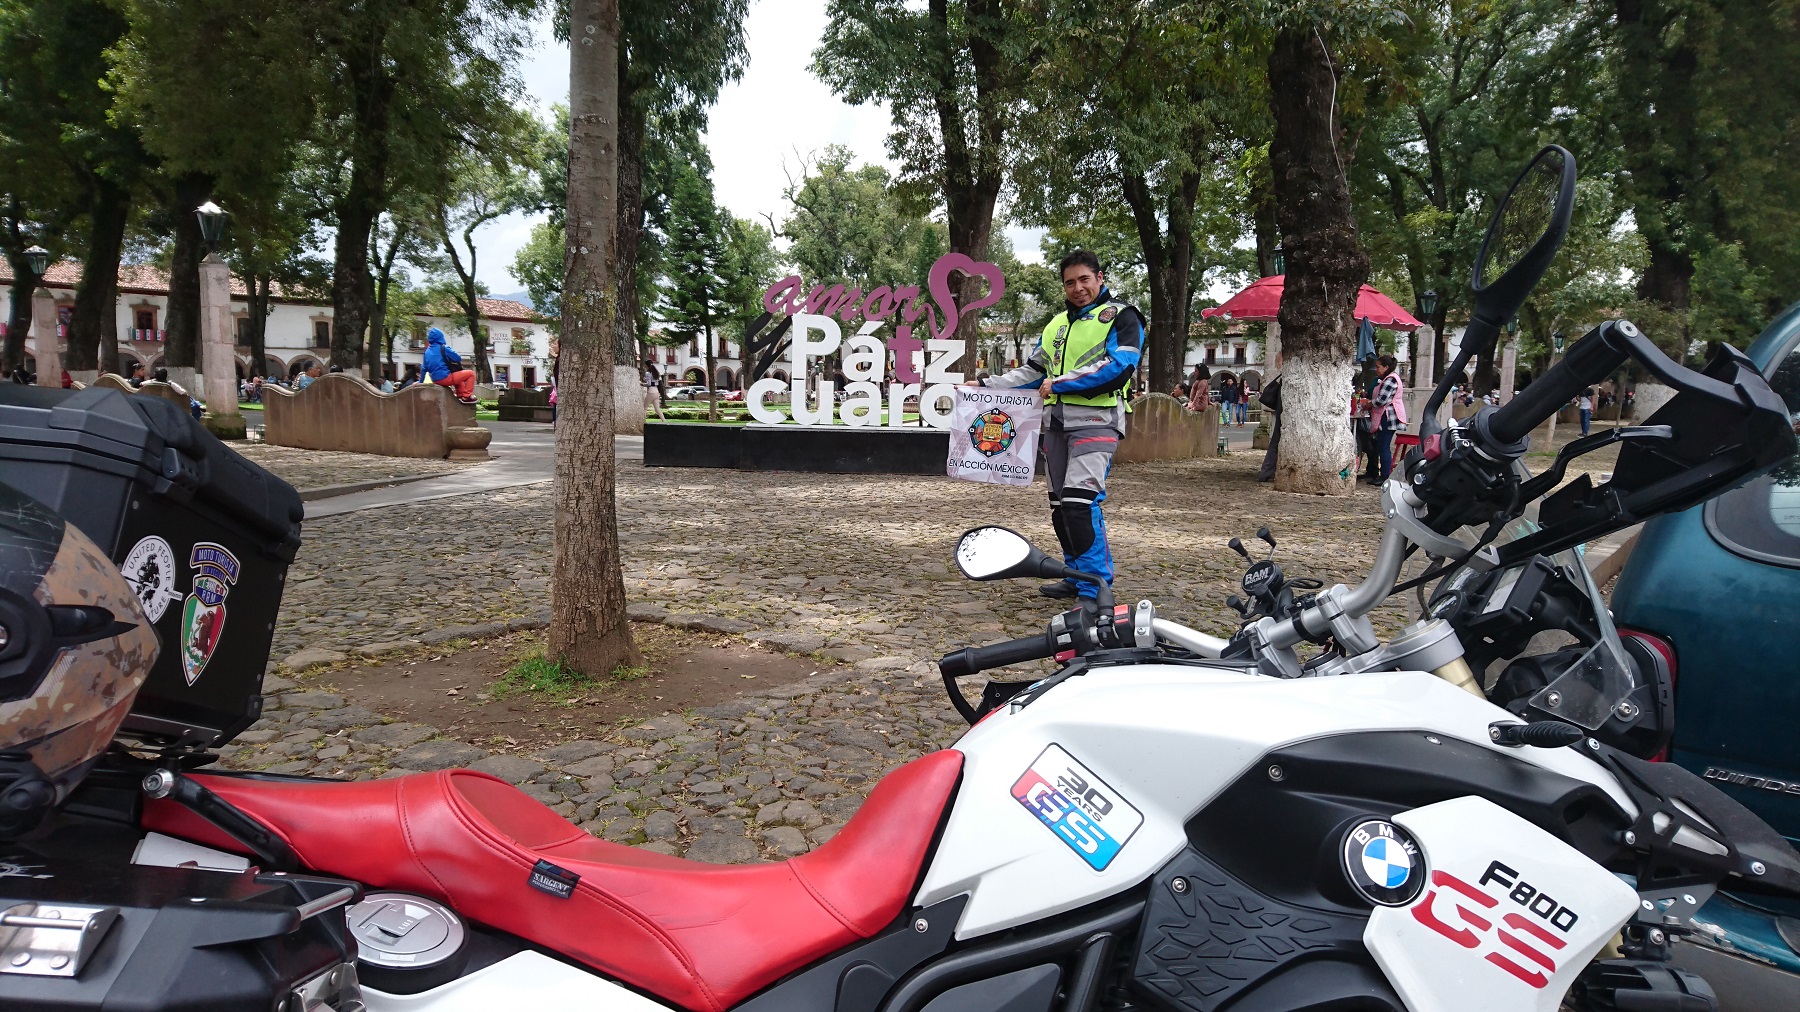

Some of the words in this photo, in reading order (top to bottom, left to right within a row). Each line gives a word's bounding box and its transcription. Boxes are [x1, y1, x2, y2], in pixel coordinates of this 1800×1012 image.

[764, 275, 922, 322] amor
[747, 378, 954, 430] cuaro
[963, 392, 993, 403] MOTO
[995, 395, 1033, 406] TURISTA
[949, 459, 957, 467] EN
[959, 460, 993, 471] ACCIÓN
[994, 463, 1030, 474] MÉXICO
[128, 542, 155, 569] UNITED
[157, 545, 171, 581] PEOPLE
[214, 551, 235, 574] TURISTA
[1245, 567, 1269, 581] RAM
[1056, 779, 1103, 822] YEARS
[1058, 767, 1113, 816] 30
[1026, 781, 1106, 855] GS
[1354, 824, 1418, 856] BMW
[533, 873, 570, 891] SARGENT
[1478, 859, 1579, 933] F800
[1411, 869, 1568, 989] GS
